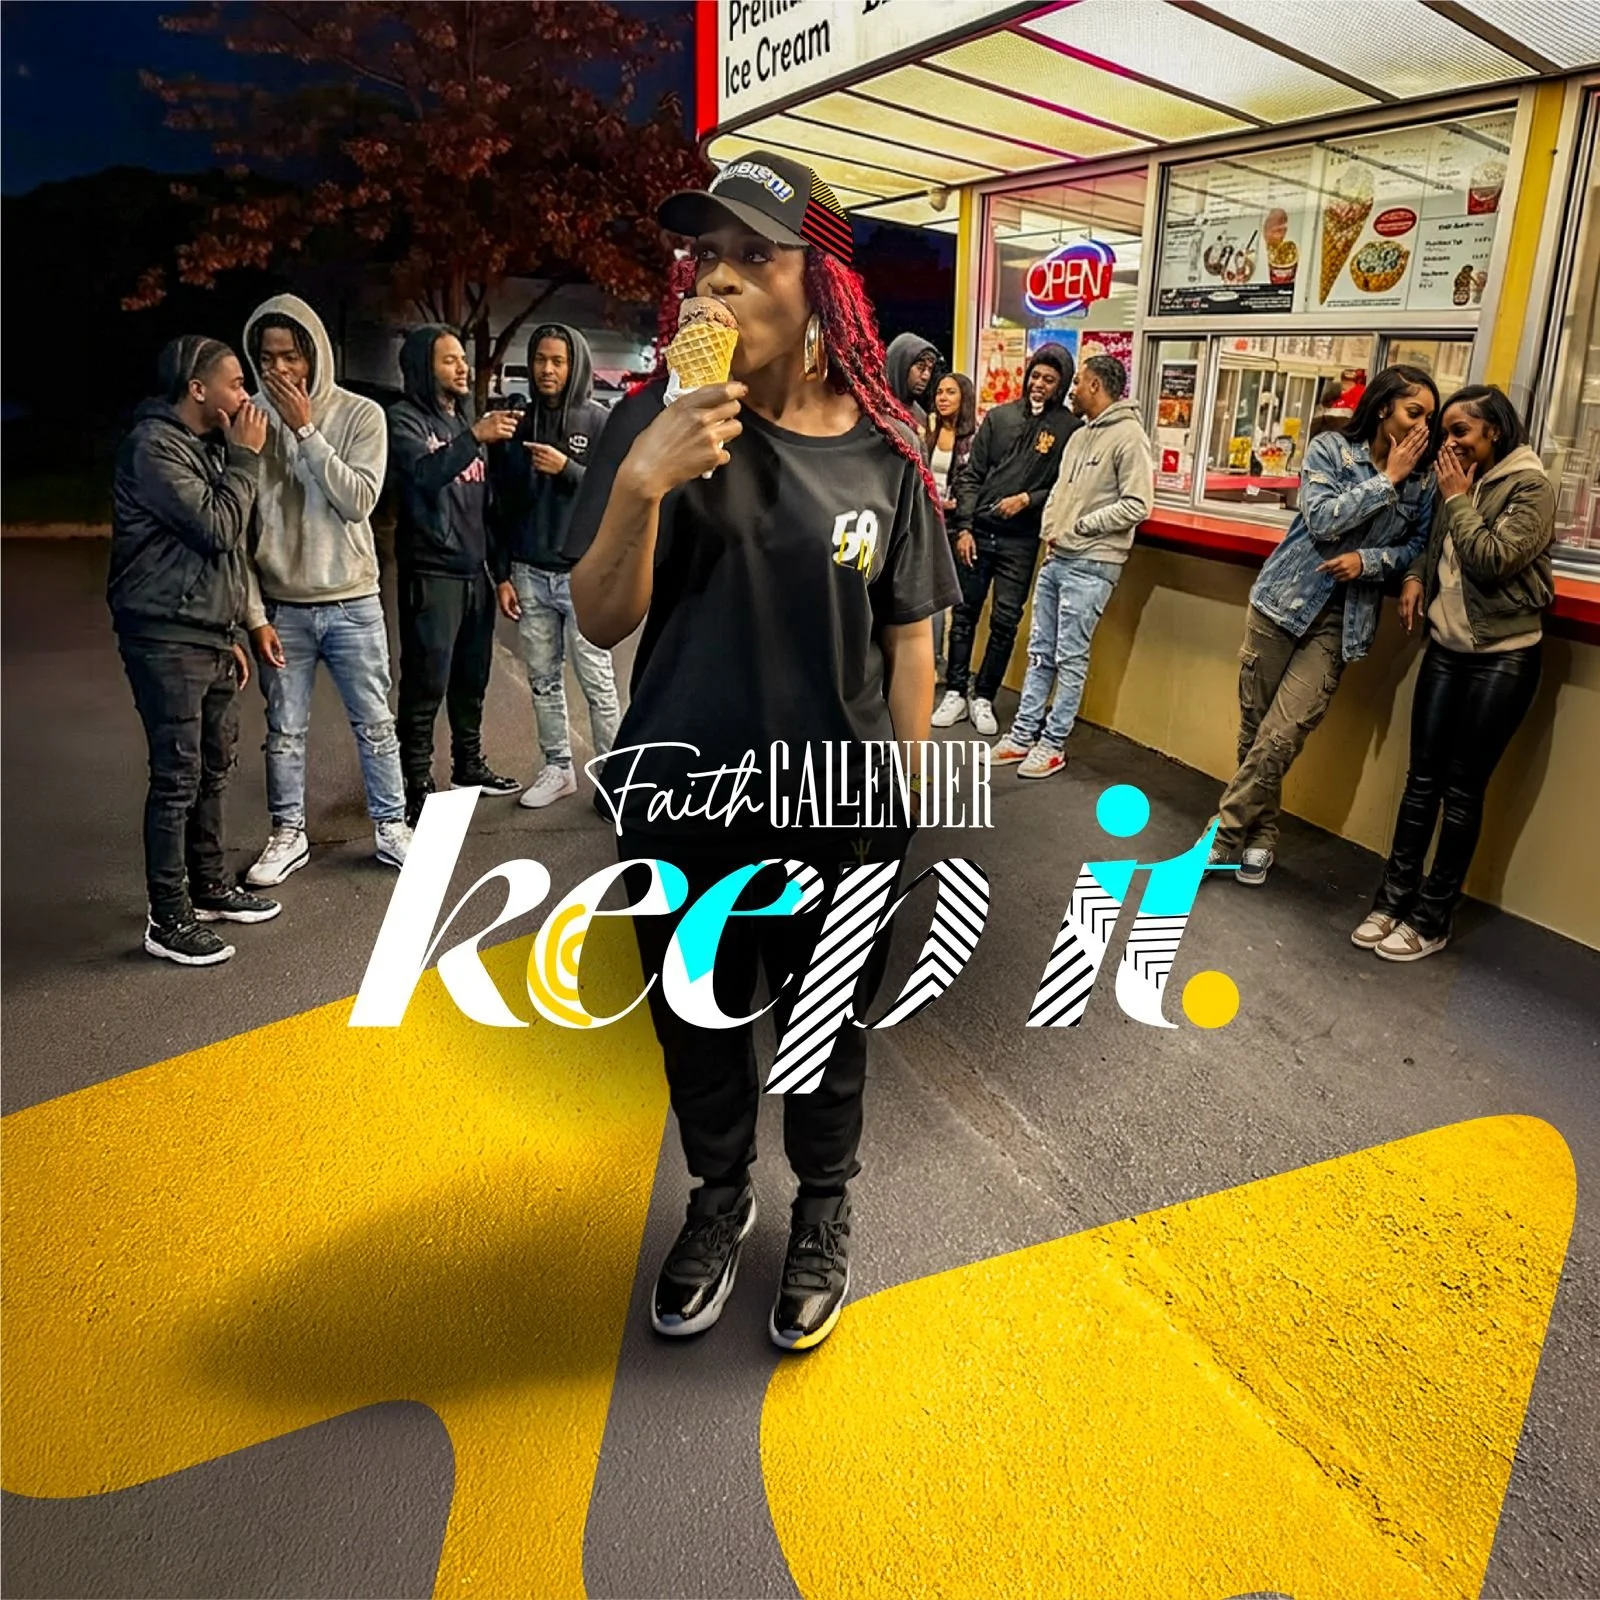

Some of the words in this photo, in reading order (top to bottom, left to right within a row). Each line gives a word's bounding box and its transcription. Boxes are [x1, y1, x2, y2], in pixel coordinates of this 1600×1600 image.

[725, 56, 751, 98] Ice
[756, 19, 831, 82] Cream
[1026, 258, 1103, 301] OPEN
